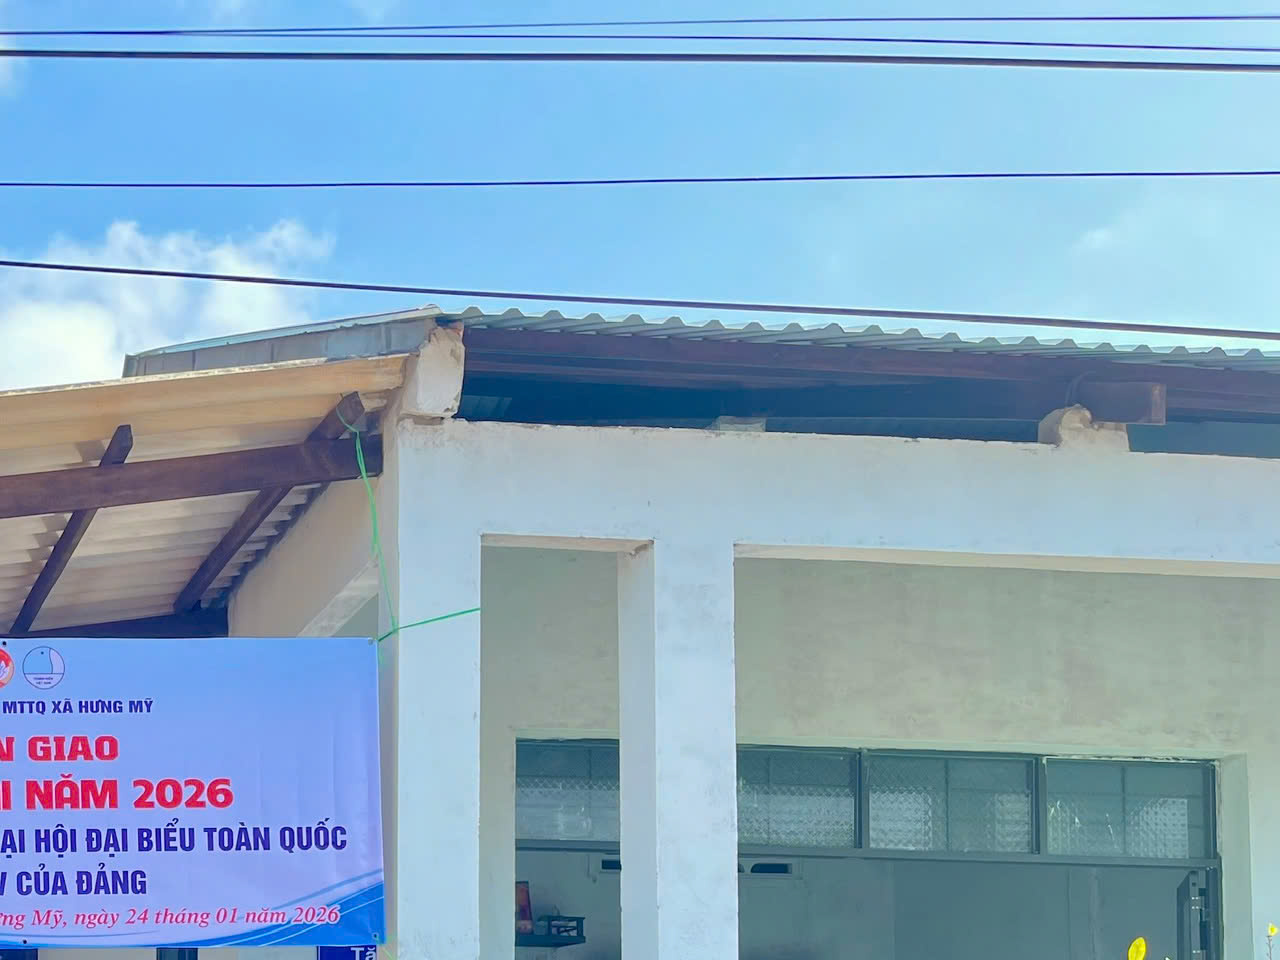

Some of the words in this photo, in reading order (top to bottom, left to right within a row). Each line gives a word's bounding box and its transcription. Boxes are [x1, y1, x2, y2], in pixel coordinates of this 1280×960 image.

[2, 700, 46, 716] MTTQ
[51, 697, 74, 714] XÃ
[78, 699, 123, 714] HƯNG
[128, 697, 154, 713] MỸ
[27, 735, 119, 762] GIAO
[25, 773, 119, 811] NĂM
[132, 778, 234, 809] 2026
[34, 823, 77, 859] HỘI
[85, 828, 129, 858] ĐẠI
[137, 817, 196, 852] BIỂU
[203, 821, 271, 852] TOÀN
[279, 817, 347, 854] QUỐC
[16, 863, 69, 896] CỦA
[75, 863, 147, 895] ĐẢNG
[31, 908, 68, 929] Mỹ,
[74, 908, 119, 929] ngày
[125, 908, 149, 925] 24
[154, 907, 211, 927] tháng
[215, 907, 238, 925] 01
[244, 907, 287, 924] năm
[292, 905, 340, 925] 2026
